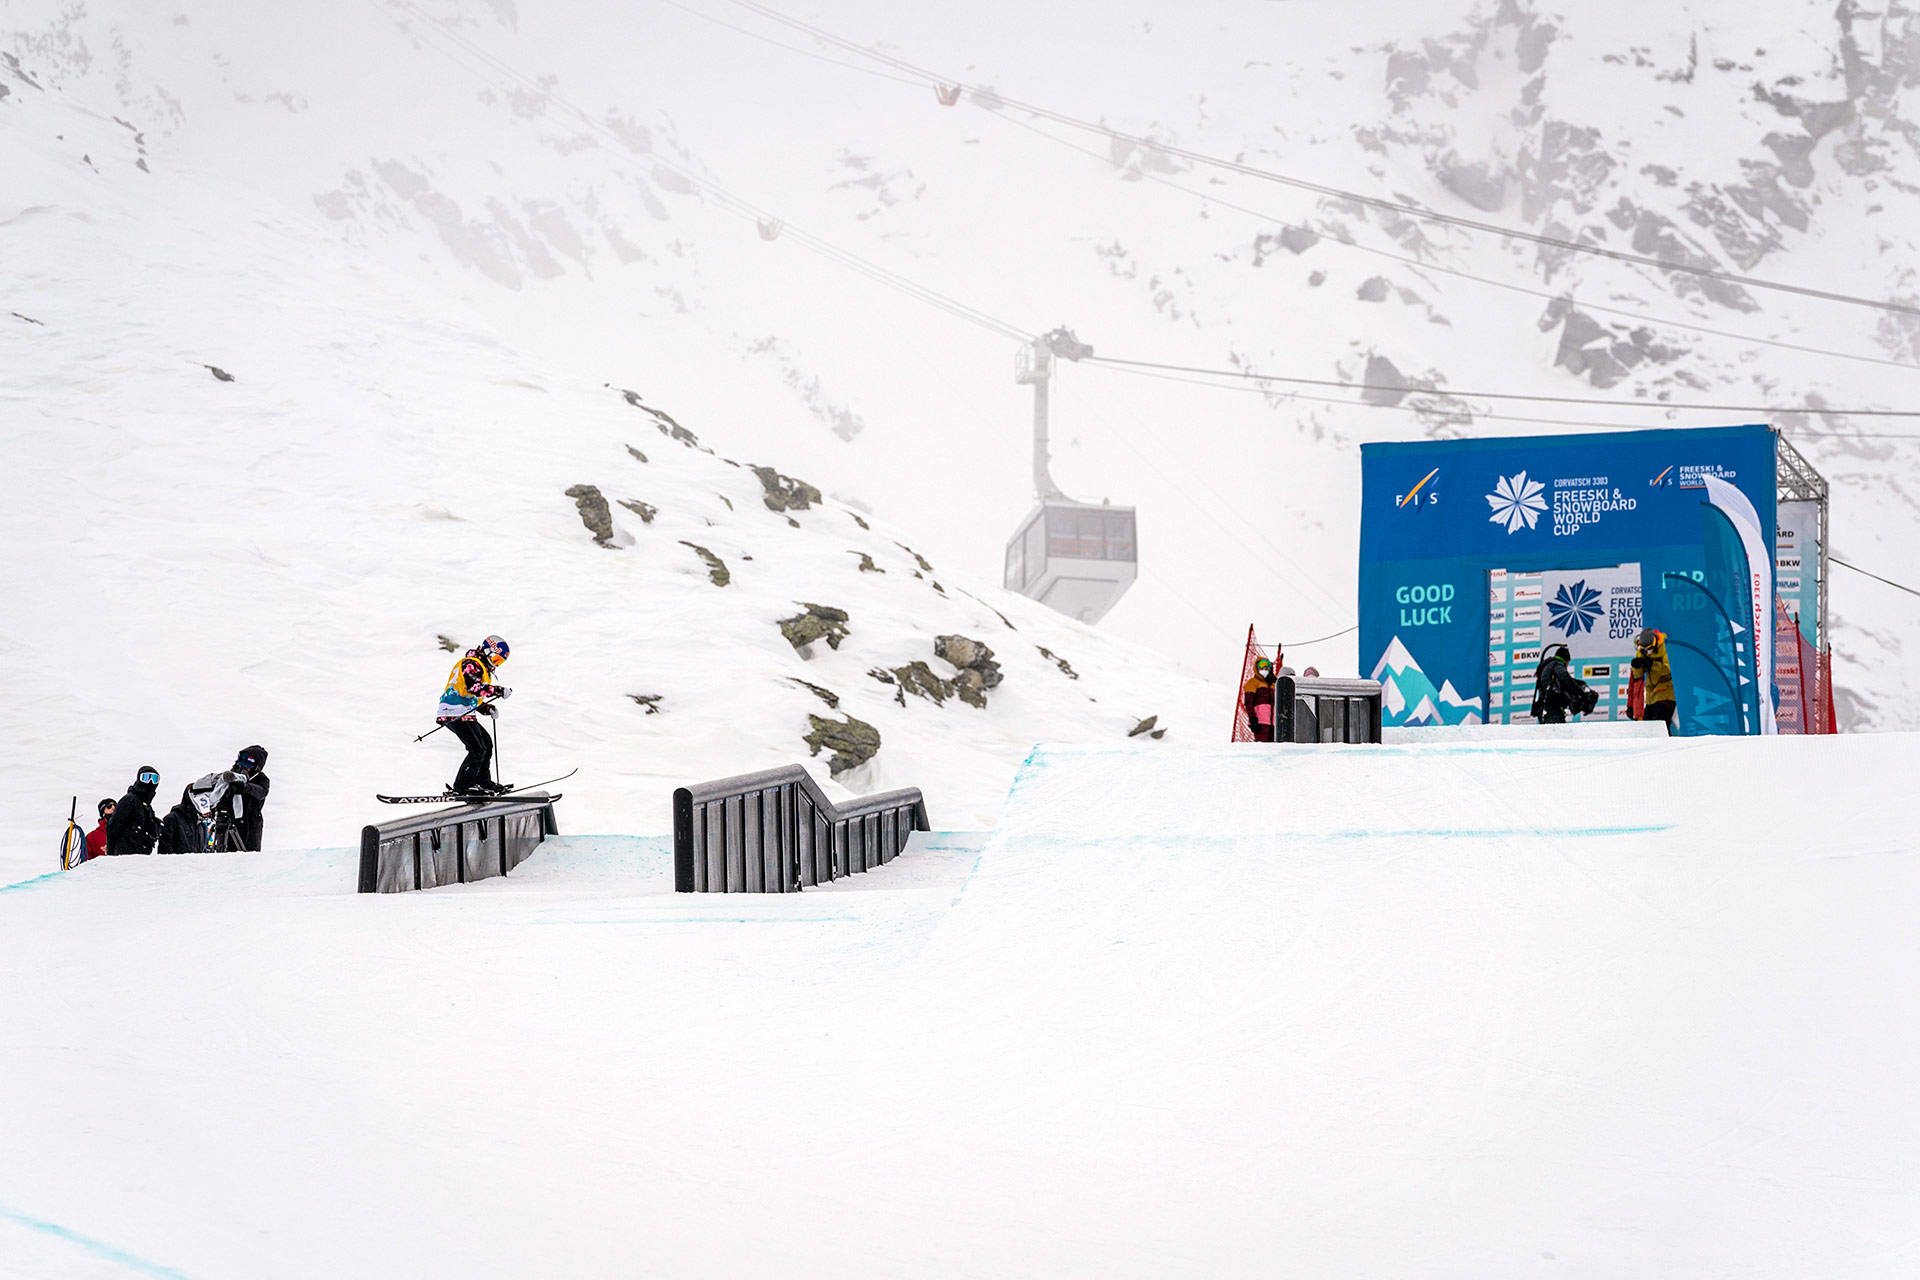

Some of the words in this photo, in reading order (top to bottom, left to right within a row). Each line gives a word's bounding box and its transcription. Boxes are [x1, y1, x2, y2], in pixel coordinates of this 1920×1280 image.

[1554, 478, 1591, 487] CORVATSCH
[1593, 477, 1608, 485] 3303
[1396, 493, 1438, 506] FIS
[1554, 489, 1608, 502] FREESKI
[1613, 488, 1622, 499] &
[1553, 499, 1637, 513] SNOWBOARD
[1553, 512, 1601, 525] WORLD
[1554, 524, 1580, 536] CUP
[1396, 584, 1455, 604] GOOD
[1610, 597, 1642, 608] FREE
[1400, 606, 1452, 626] LUCK
[1609, 629, 1634, 639] CUP
